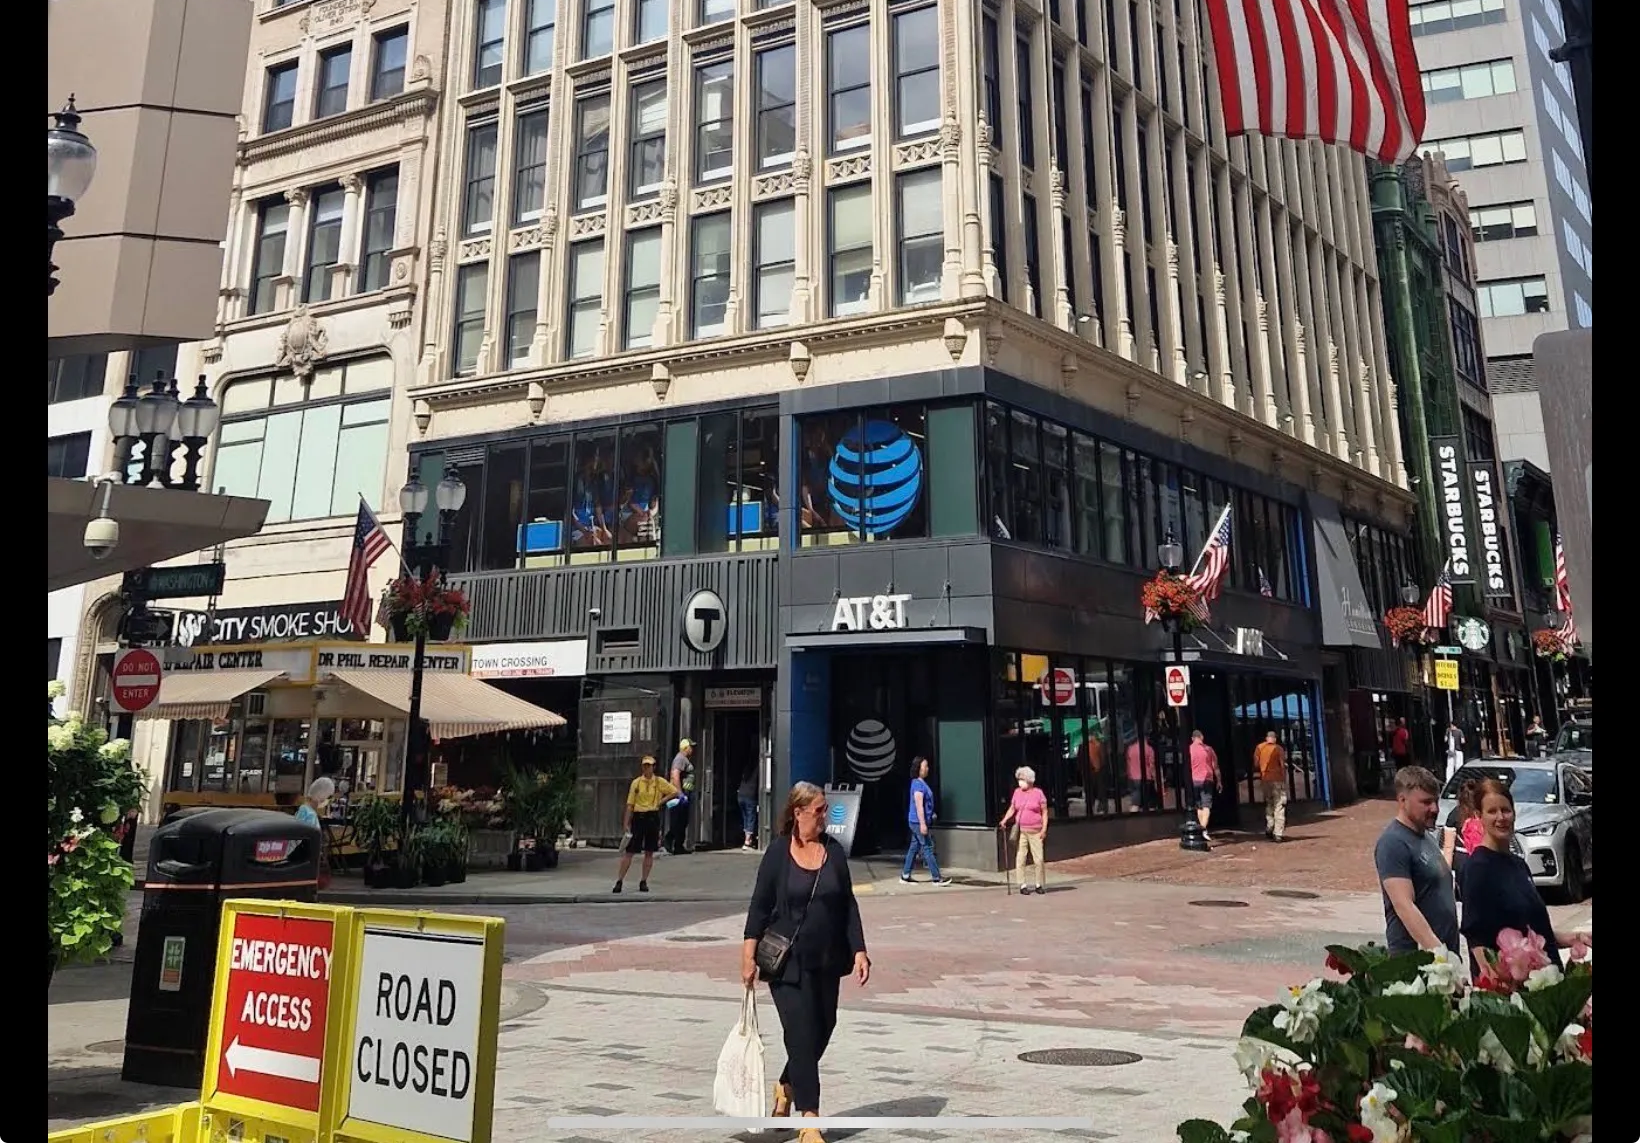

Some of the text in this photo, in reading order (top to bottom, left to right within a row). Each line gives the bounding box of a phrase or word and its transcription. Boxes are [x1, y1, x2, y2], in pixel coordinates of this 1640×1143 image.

[1439, 445, 1469, 576] STARBUCKS
[1474, 469, 1504, 591] STARBUCKS
[250, 613, 309, 638] SMOKE
[313, 611, 354, 635] SHO
[694, 607, 720, 643] T
[832, 593, 912, 631] AT&T
[122, 662, 134, 672] DO
[137, 662, 154, 672] NOT
[219, 651, 263, 668] CENTER
[318, 653, 459, 669] DR PHIL REPAIR ENTER
[473, 656, 548, 668] TOWN CROSSING
[122, 688, 149, 699] ENTER
[231, 938, 332, 980] EMERGENCY
[240, 990, 312, 1032] ACCESS
[376, 971, 457, 1027] ROAD
[357, 1036, 471, 1100] CLOSED
